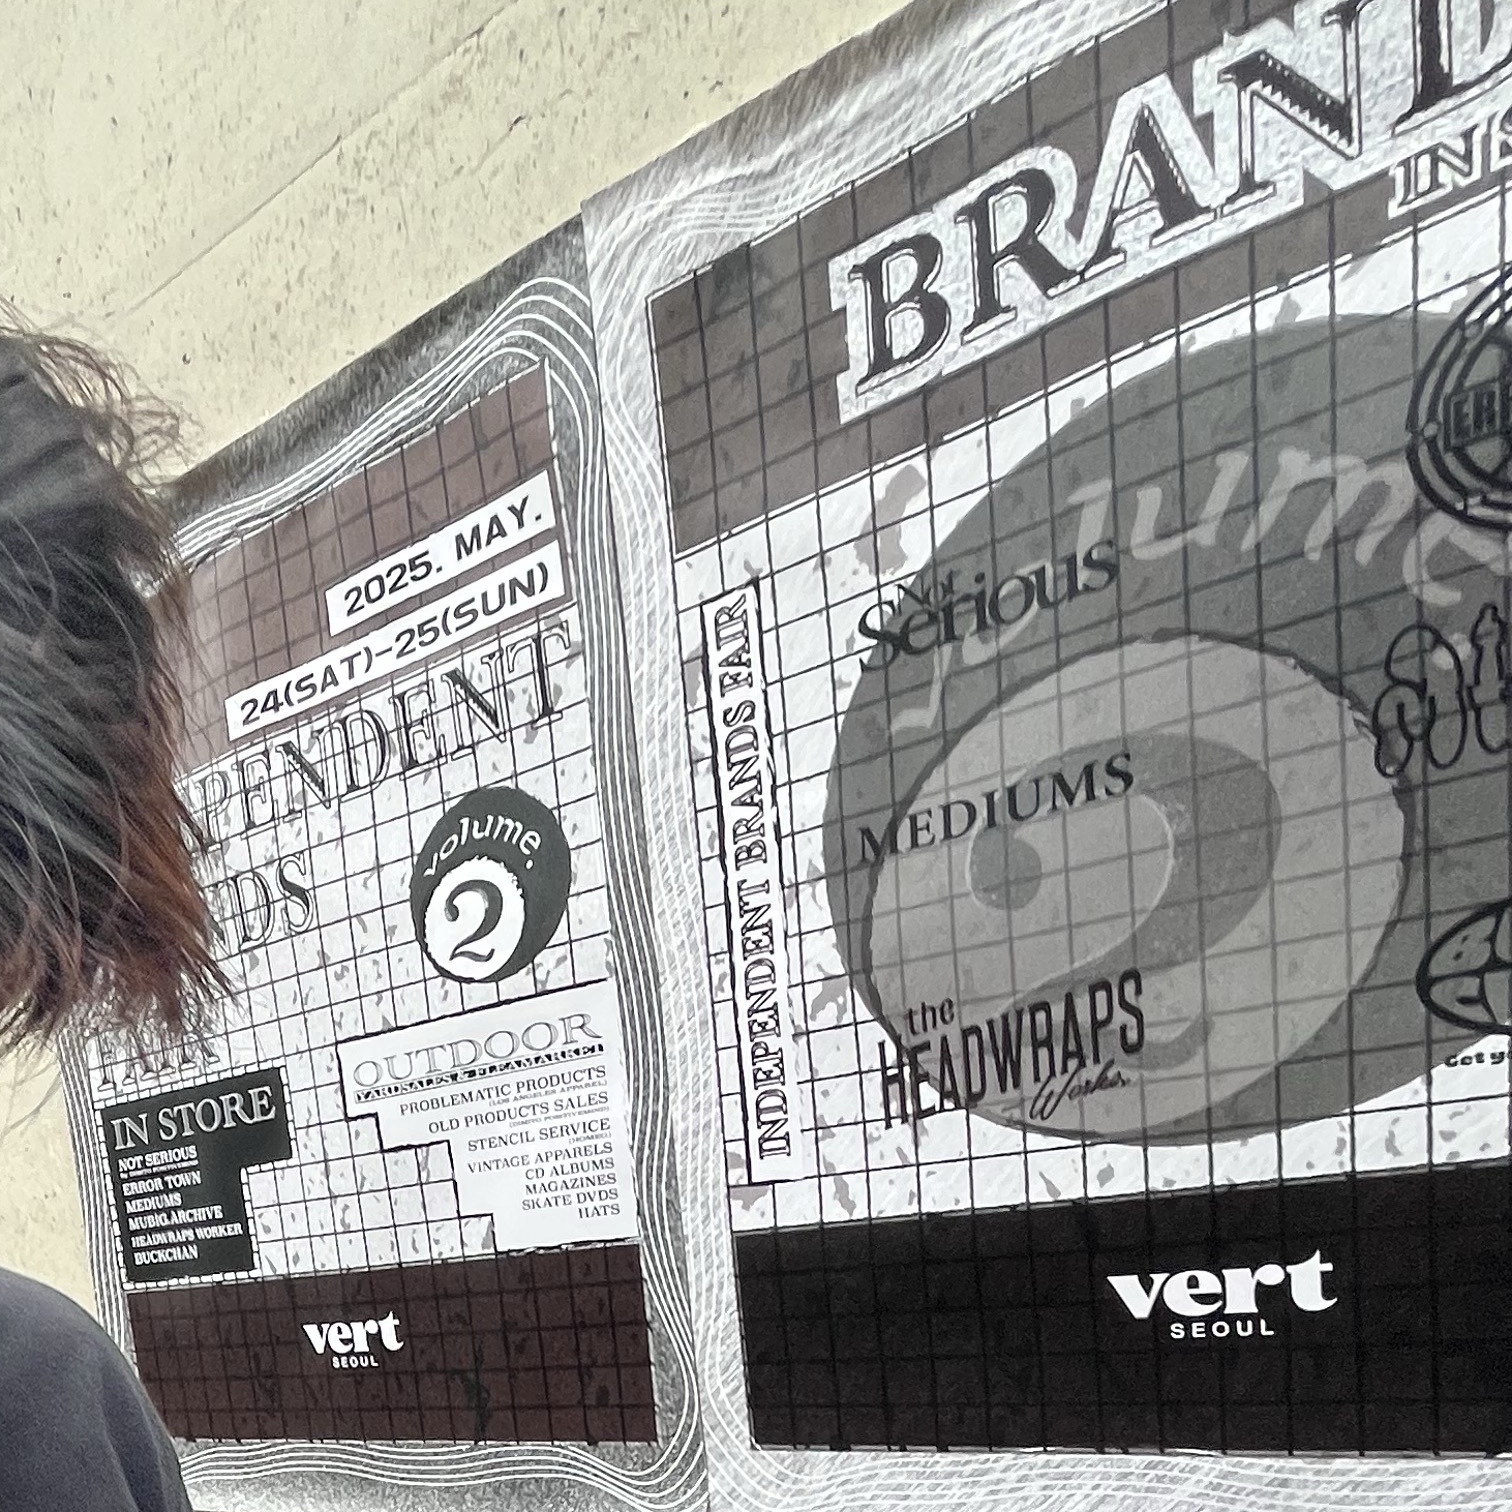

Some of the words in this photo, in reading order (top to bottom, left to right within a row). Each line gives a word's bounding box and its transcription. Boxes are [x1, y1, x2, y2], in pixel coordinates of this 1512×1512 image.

[344, 549, 443, 617] 2025.
[454, 495, 542, 562] MAY.
[858, 539, 1120, 672] Serious
[240, 561, 549, 726] 24(SAT)-25(SUN)
[714, 594, 753, 698] FAIR
[191, 618, 571, 853] PENDENT
[723, 702, 767, 871] BRANDS
[859, 750, 1134, 866] MEDIUMS
[444, 879, 496, 962] 2
[737, 878, 792, 1160] INDEPENDENT
[905, 998, 955, 1037] the
[353, 1013, 604, 1088] OUTDOOR
[877, 967, 1146, 1130] HEADWRAPS
[399, 1083, 512, 1116] PROBLEMATIC
[516, 1065, 606, 1095] PRODUCTS
[110, 1113, 150, 1151] IN
[157, 1086, 276, 1141] STORE
[428, 1117, 460, 1134] OLD
[464, 1101, 549, 1128] PRODUCTS
[553, 1091, 609, 1112] SALES
[468, 1129, 535, 1152] STENCIL
[539, 1117, 611, 1141] SERVICE
[117, 1154, 144, 1173] NOT
[145, 1145, 198, 1167] SERIOUS
[467, 1154, 531, 1175] VINTAGE
[534, 1141, 613, 1165] APPARELS
[524, 1166, 545, 1181] CD
[549, 1157, 615, 1178] ALBUMS
[122, 1177, 164, 1196] ERROR
[164, 1170, 202, 1189] TOWN
[124, 1191, 183, 1214] MEDIUMS
[521, 1195, 573, 1212] SKATE
[576, 1187, 619, 1205] DVDS
[524, 1172, 617, 1196] MAGAZINES
[578, 1203, 621, 1220] HATS
[131, 1228, 195, 1249] HEADWRAPS
[196, 1222, 243, 1240] WORKER
[134, 1244, 199, 1266] BUCKCHAN
[1106, 1249, 1338, 1320] vert
[302, 1310, 405, 1354] vert
[1170, 1318, 1275, 1340] SEOUL
[332, 1355, 380, 1369] SEOUL
